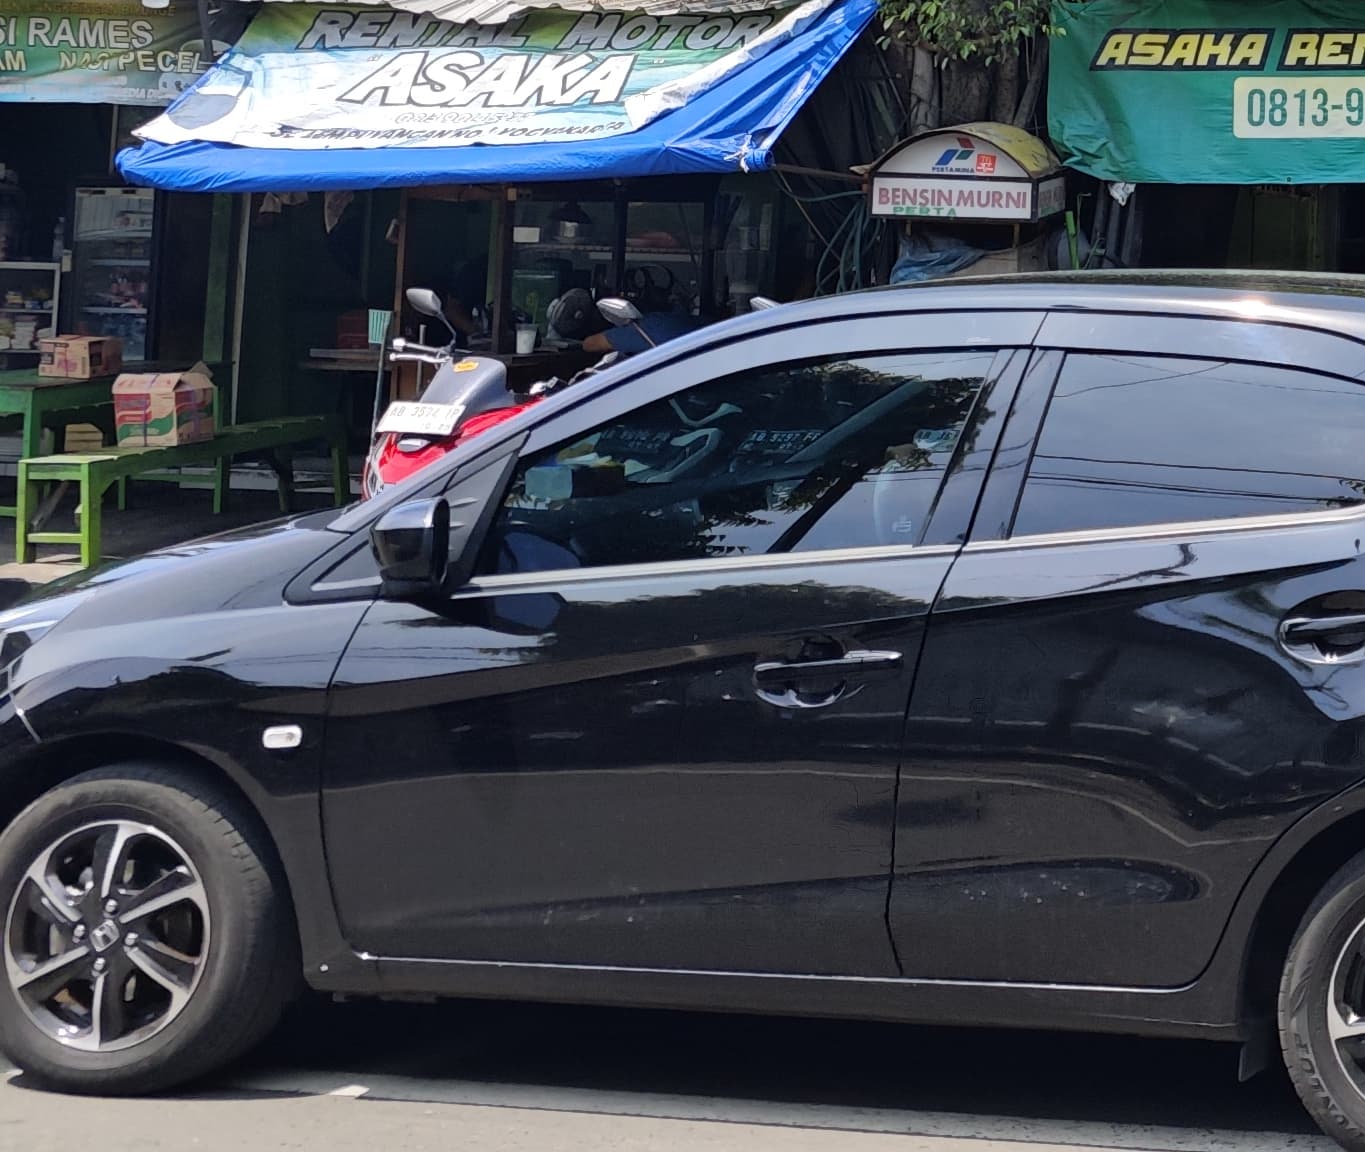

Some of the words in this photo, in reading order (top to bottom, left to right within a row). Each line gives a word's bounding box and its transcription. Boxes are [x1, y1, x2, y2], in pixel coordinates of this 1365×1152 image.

[28, 18, 153, 49] RAMES
[296, 10, 530, 50] RENTAL
[555, 11, 775, 51] MOTOR
[118, 51, 209, 75] PECEL
[1093, 30, 1270, 68] ASAKA
[878, 187, 953, 208] BENSIN
[956, 189, 1027, 209] MURNI
